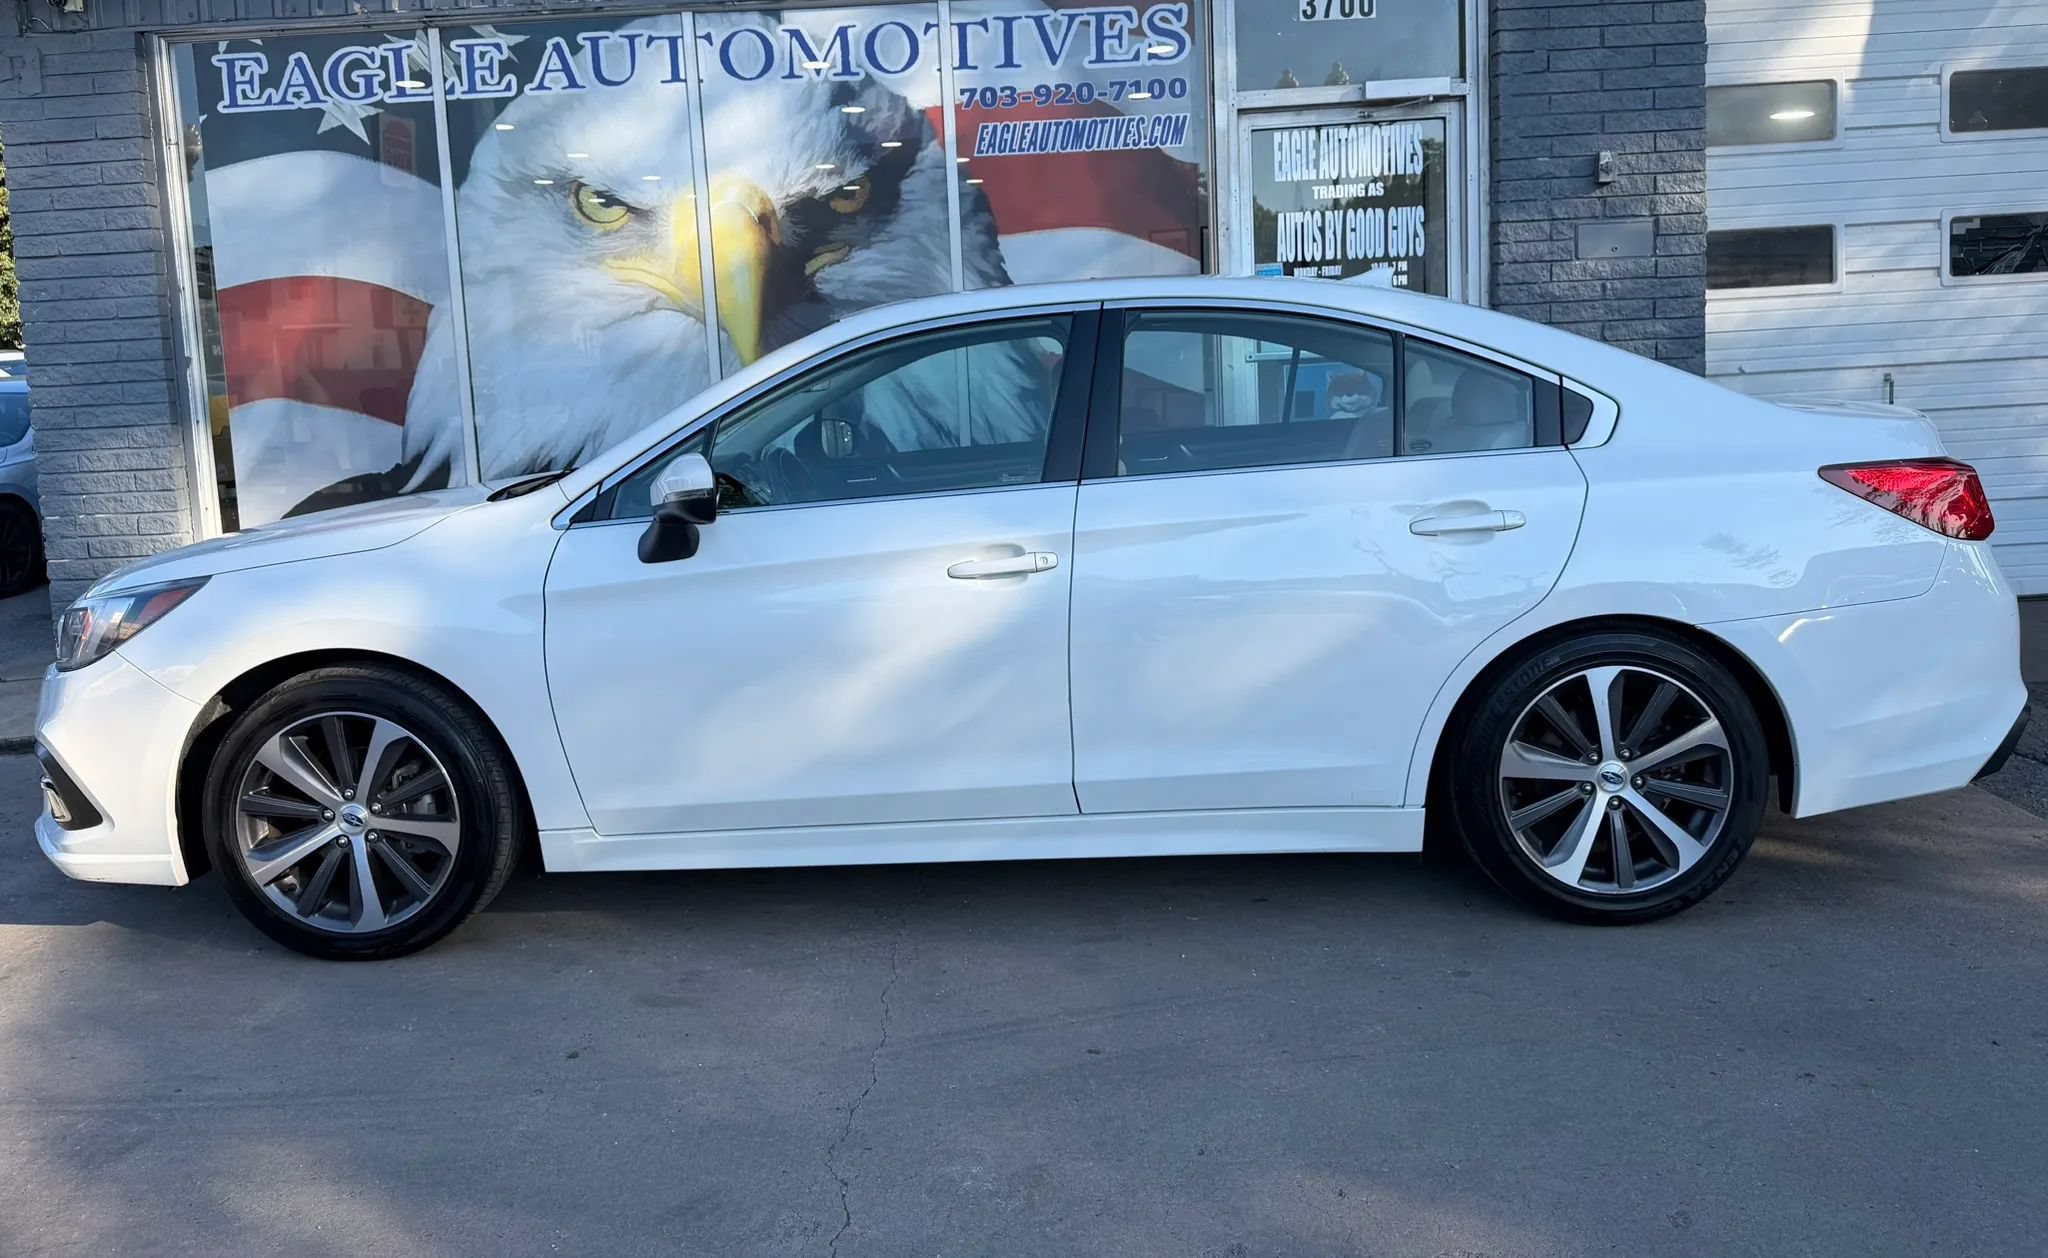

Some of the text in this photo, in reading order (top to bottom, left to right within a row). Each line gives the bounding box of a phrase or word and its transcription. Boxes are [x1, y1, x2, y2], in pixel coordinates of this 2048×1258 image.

[1302, 0, 1374, 20] 3700
[215, 4, 1187, 112] EAGLE AUTOMOTIVES
[960, 78, 1188, 111] 703-920-7100
[974, 114, 1187, 157] EAGLEAUTOMOTIVES.COM
[1274, 123, 1424, 182] EAGLE AUTOMOTIVES
[1312, 182, 1384, 199] TRADING AS
[1277, 205, 1425, 263] AUTOS BY GOOD GUYS
[1293, 266, 1318, 278] MONDAY
[1321, 264, 1343, 277] FRIDAY
[1397, 260, 1408, 272] PM
[1398, 274, 1408, 286] PM
